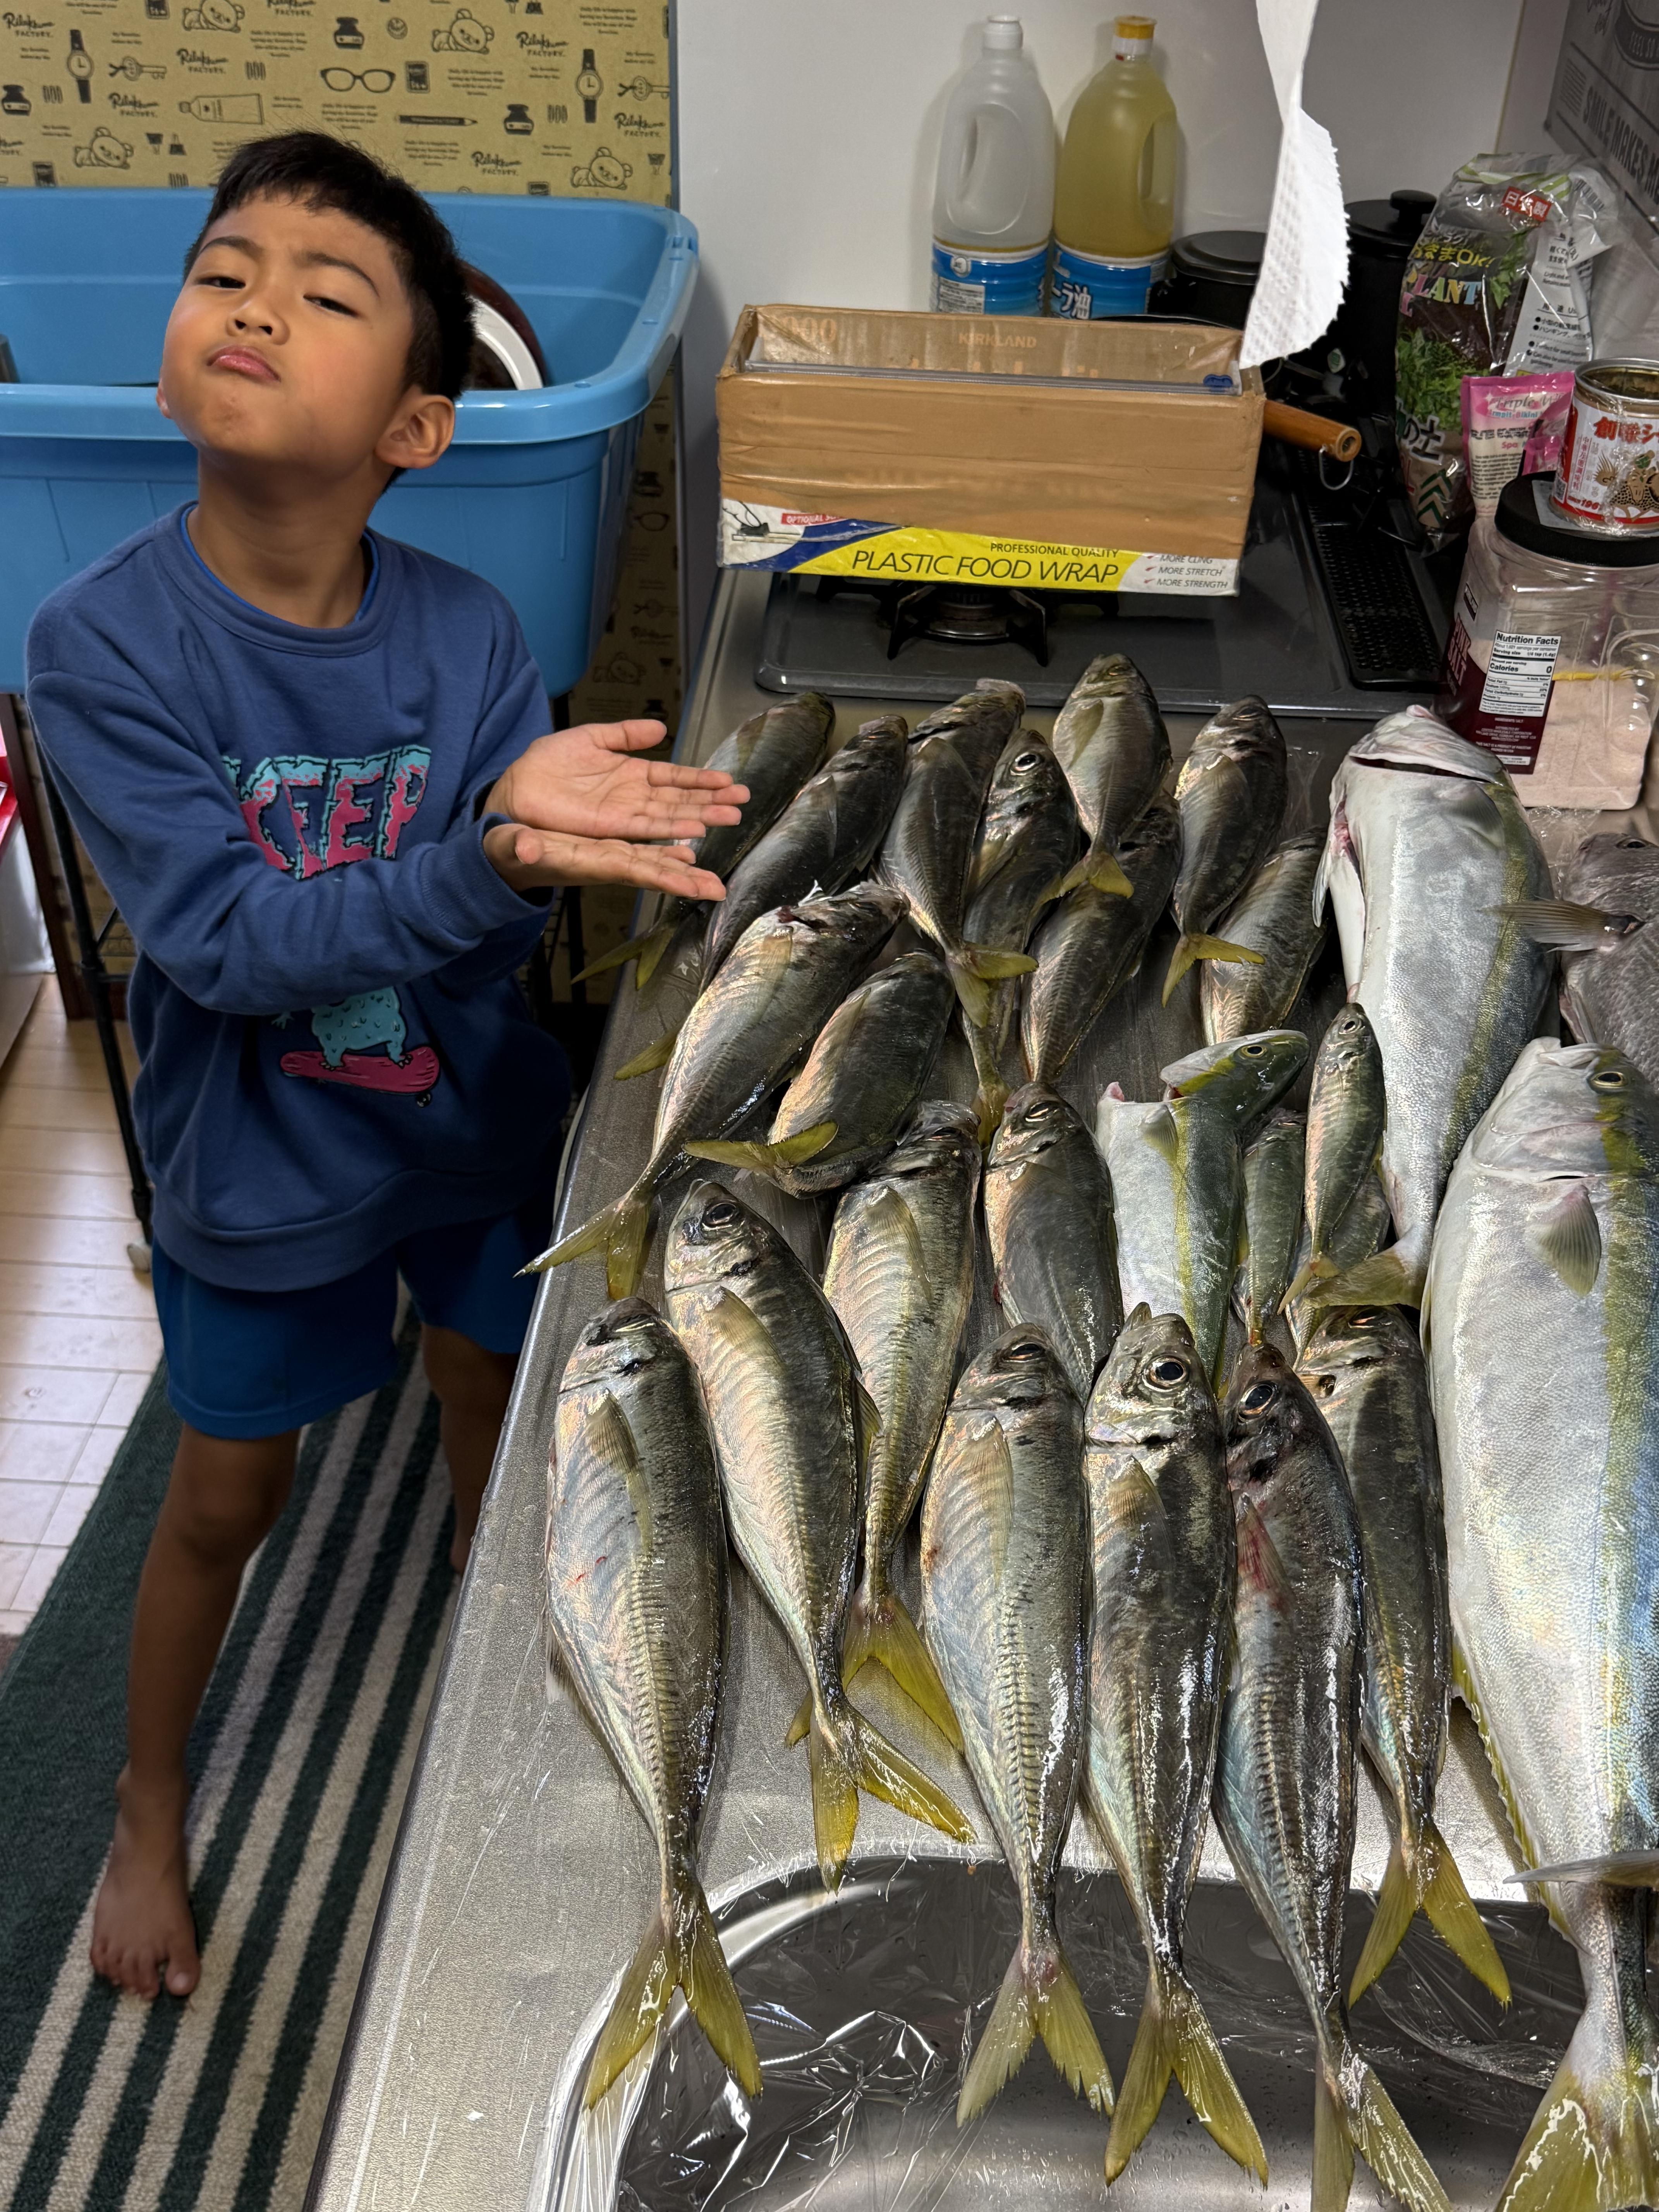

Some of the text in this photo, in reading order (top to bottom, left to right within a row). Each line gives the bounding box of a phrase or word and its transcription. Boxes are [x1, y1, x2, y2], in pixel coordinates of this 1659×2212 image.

[1505, 191, 1548, 218] 日製
[959, 332, 1037, 349] KIRKLAND
[786, 514, 823, 524] OPTIONAL
[990, 543, 1119, 558] PROFESSIONAL QUALITY
[1159, 555, 1213, 564] MORE CLING
[852, 550, 1118, 583] PLASTIC FOOD WRAP
[1158, 567, 1223, 576] MORE STRETCH
[1156, 579, 1228, 589] MORE STRENGTH
[1496, 632, 1559, 645] Nutrition Facts
[1490, 663, 1553, 673] Calories 0
[220, 745, 432, 881] KEEP
